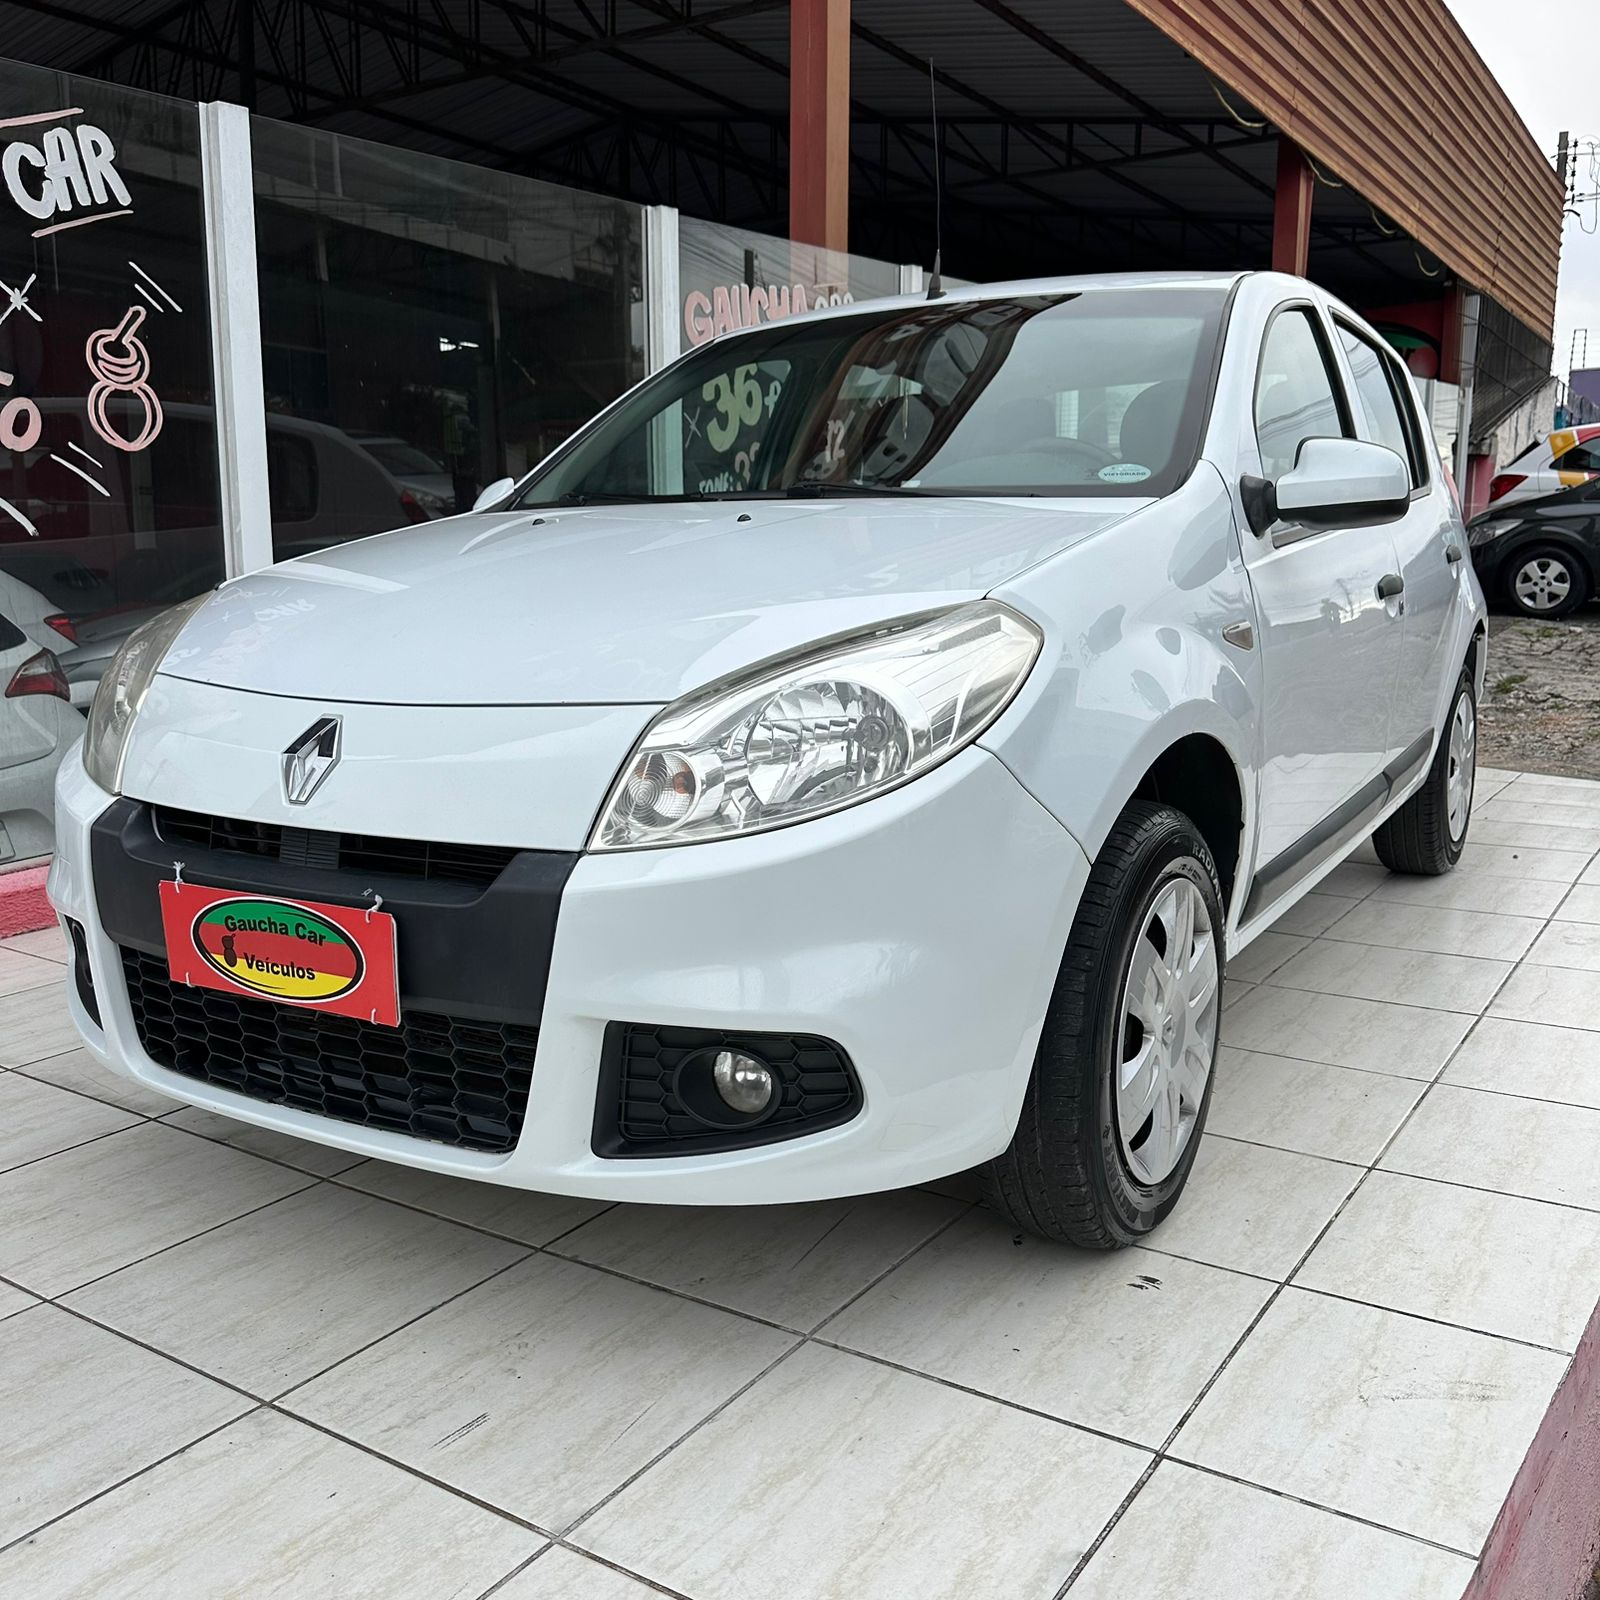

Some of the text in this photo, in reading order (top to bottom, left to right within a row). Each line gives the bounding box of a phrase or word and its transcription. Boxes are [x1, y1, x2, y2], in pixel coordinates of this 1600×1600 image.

[2, 124, 132, 220] CAR
[224, 915, 326, 946] Gaucha Car
[244, 953, 316, 980] Veículos
